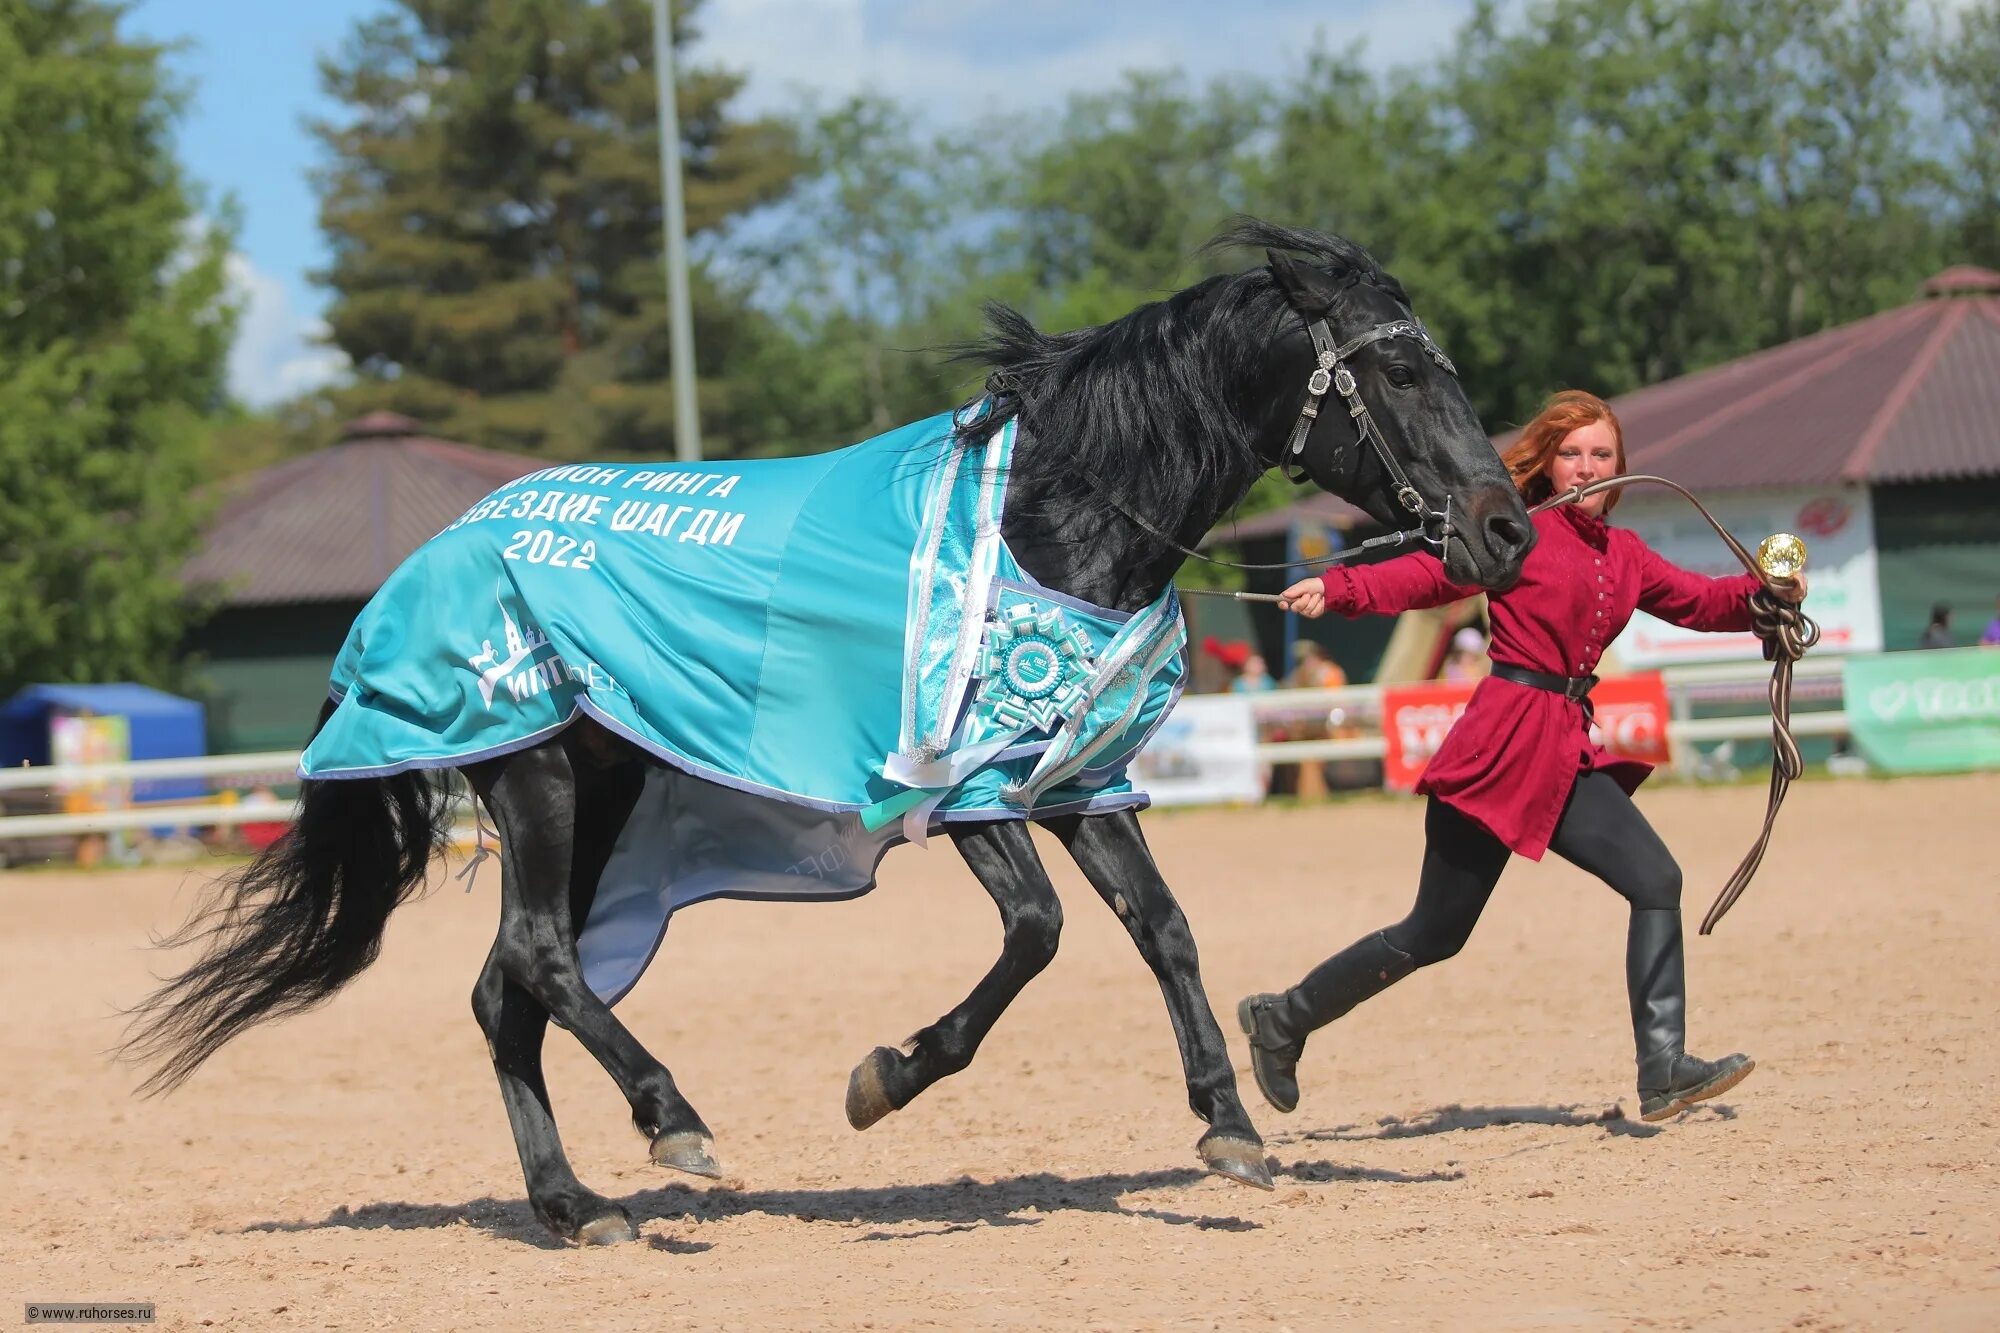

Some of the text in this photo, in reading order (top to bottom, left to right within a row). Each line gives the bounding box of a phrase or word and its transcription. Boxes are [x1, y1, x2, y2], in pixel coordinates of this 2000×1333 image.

[621, 471, 742, 498] РИНГА
[610, 500, 746, 546] ШАГДИ
[503, 529, 596, 569] 2022
